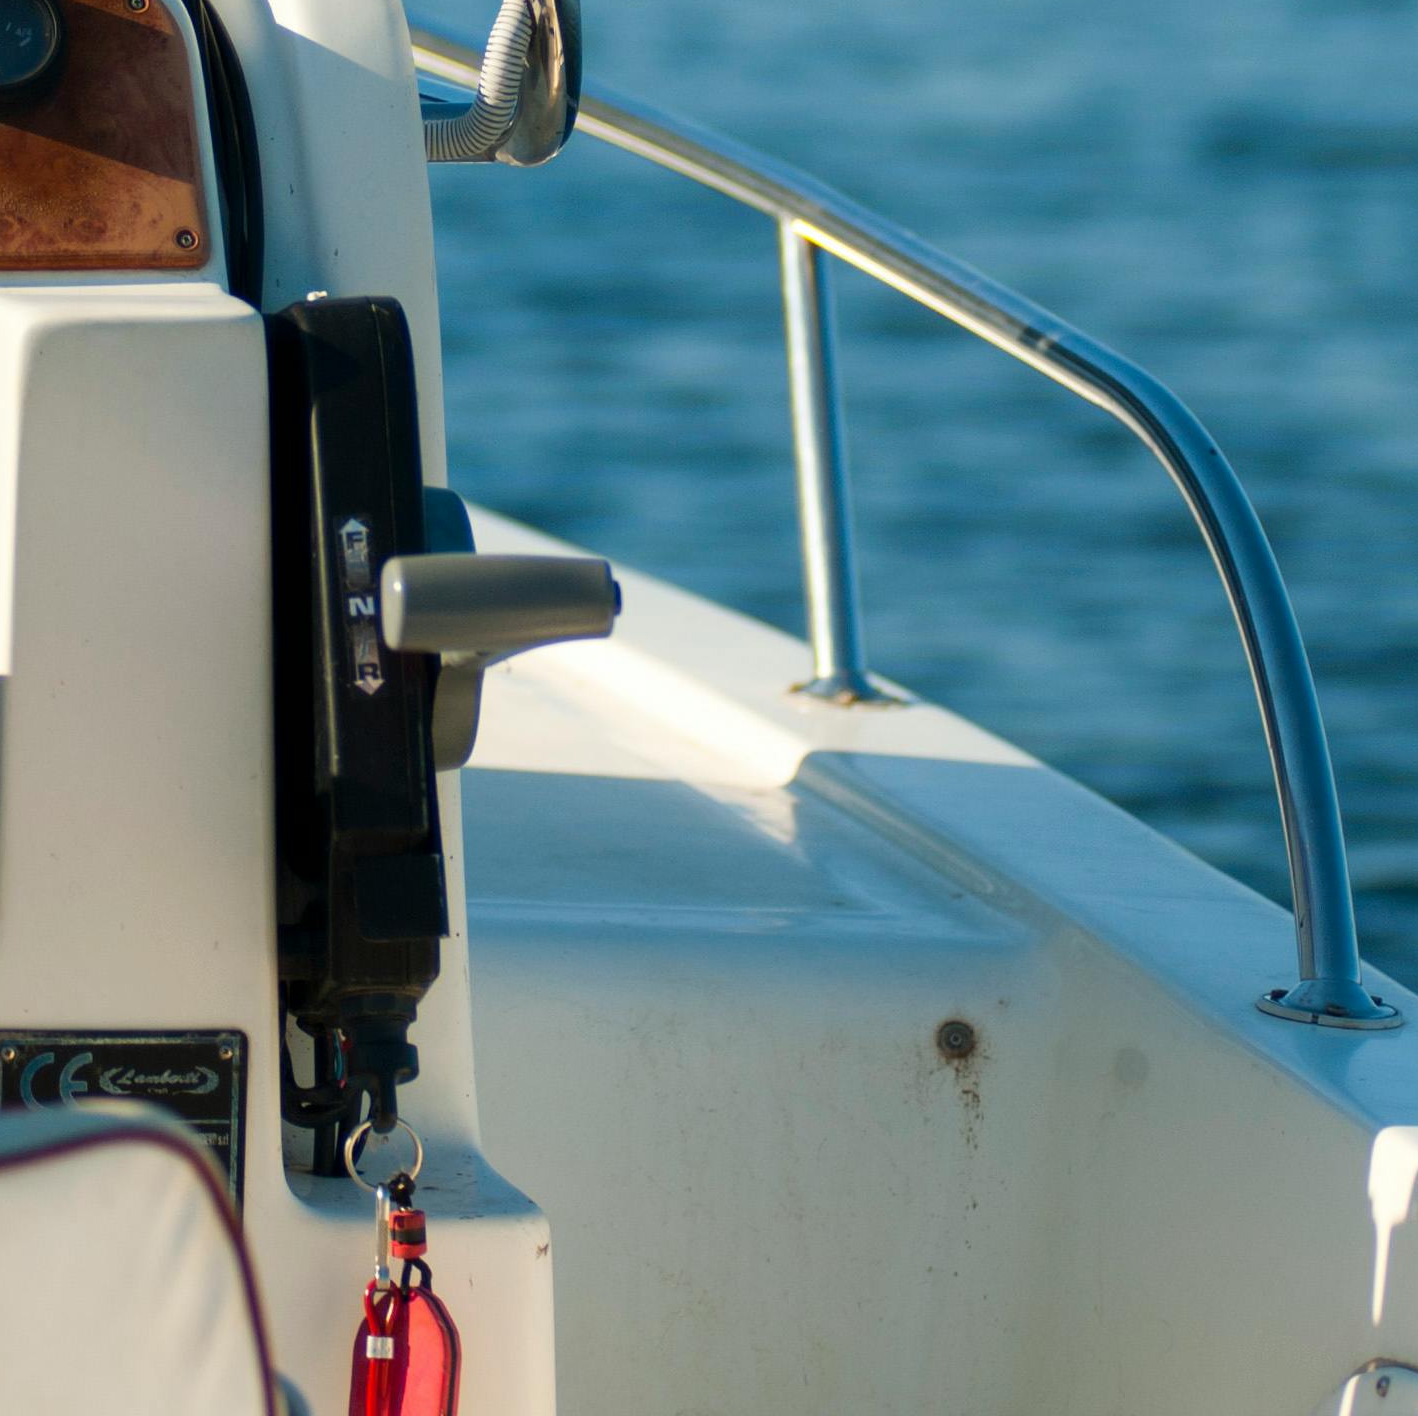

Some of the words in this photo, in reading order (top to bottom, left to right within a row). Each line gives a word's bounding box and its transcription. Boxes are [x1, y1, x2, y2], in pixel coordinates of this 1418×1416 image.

[348, 596, 375, 617] N
[358, 663, 380, 680] R
[20, 1051, 93, 1111] CE
